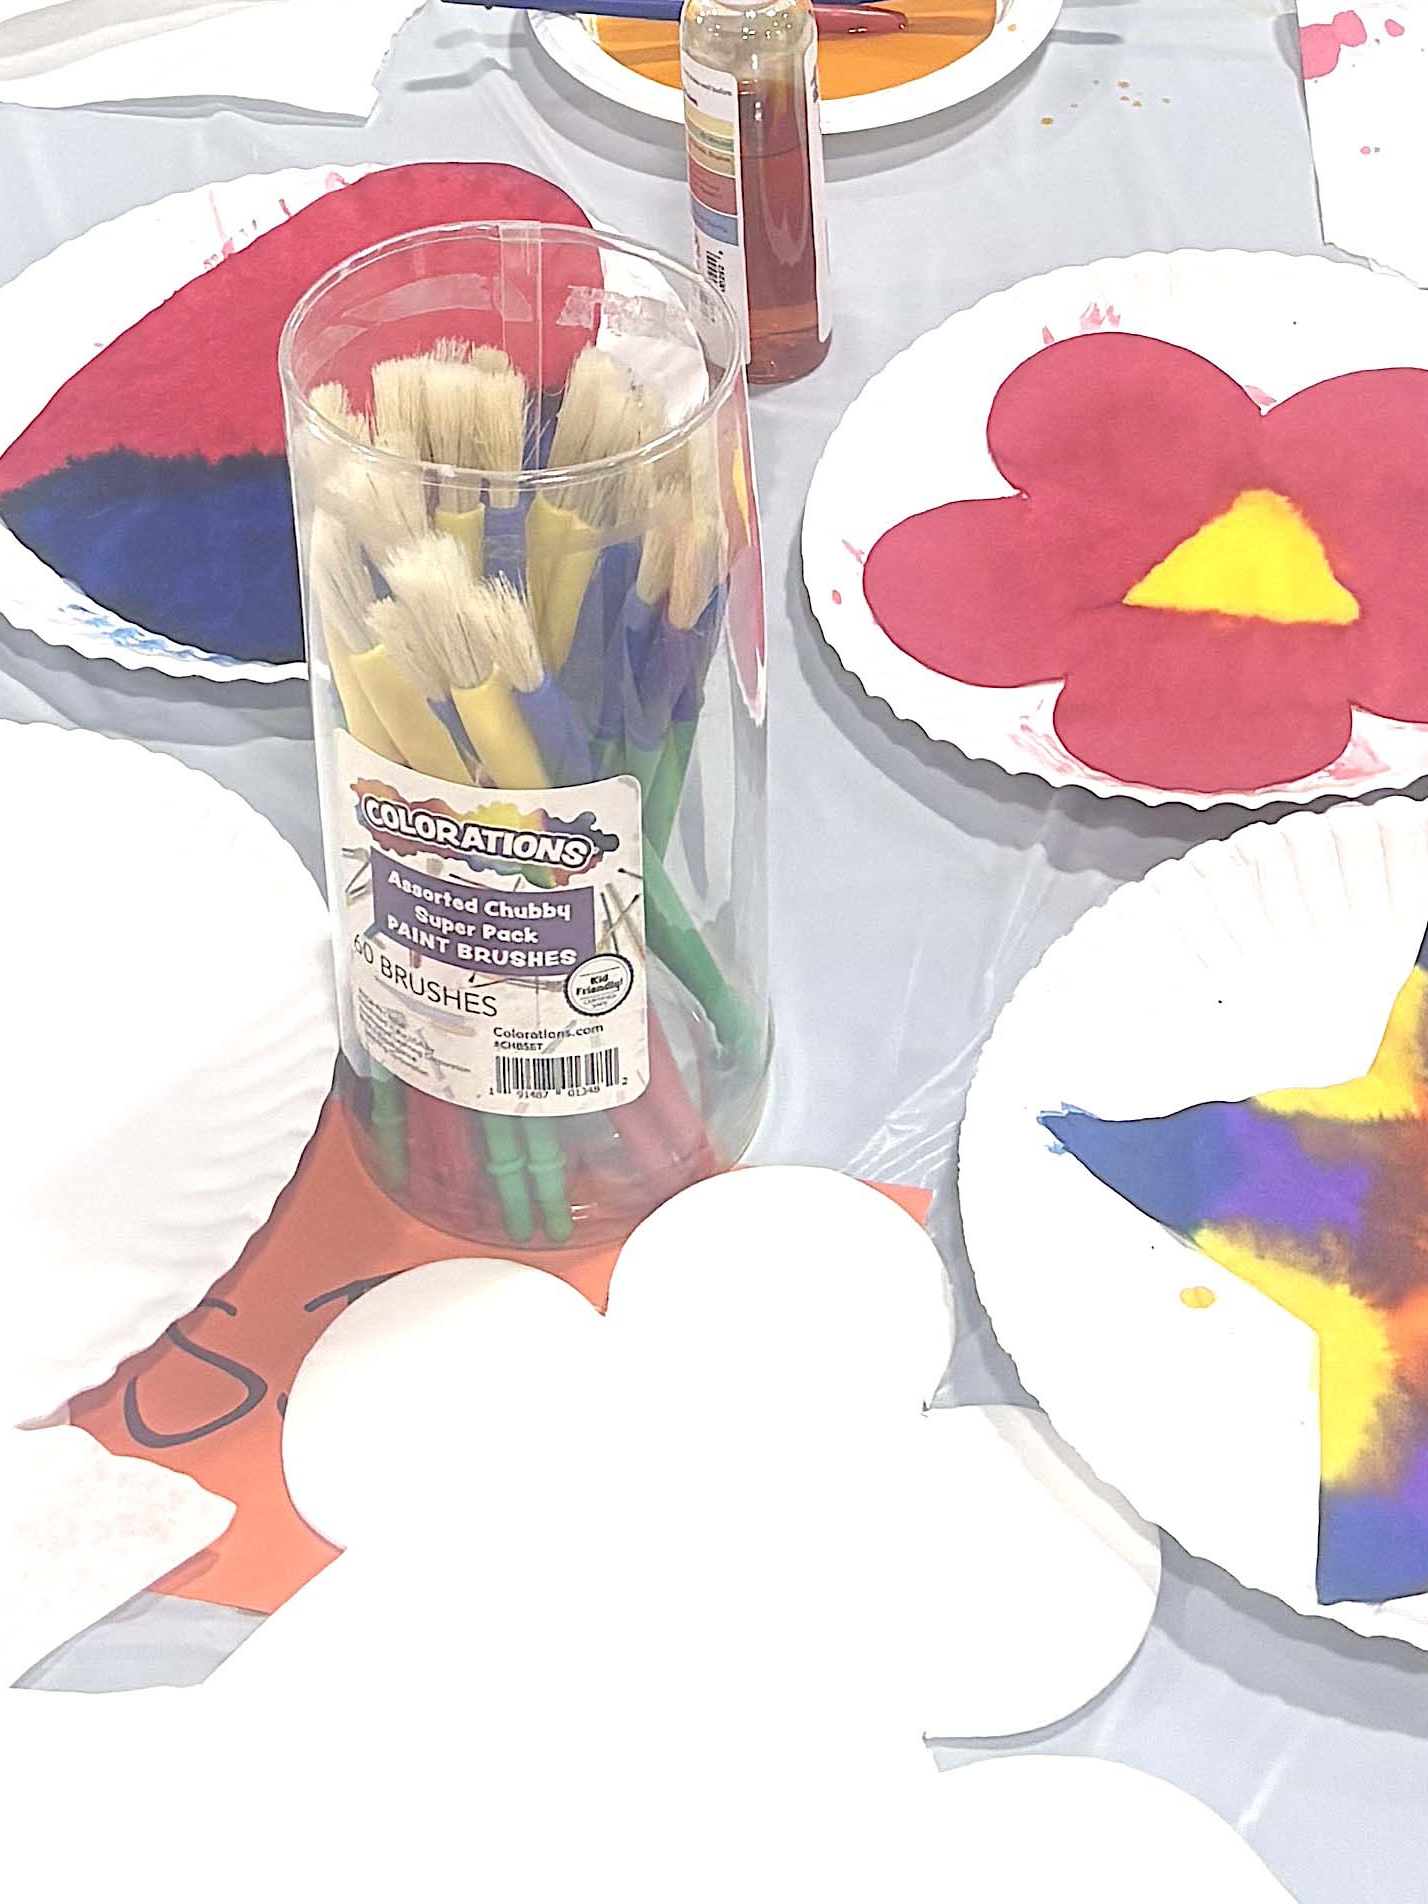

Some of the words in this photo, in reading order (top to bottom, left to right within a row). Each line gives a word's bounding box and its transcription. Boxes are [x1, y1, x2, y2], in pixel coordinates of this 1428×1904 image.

[364, 797, 587, 868] COLORATIONS
[387, 870, 478, 914] Assorted
[483, 899, 572, 922] Chubby
[387, 914, 450, 954] PAINT
[457, 941, 578, 968] BRUSHES
[414, 904, 476, 937] Super
[482, 923, 539, 944] Pack
[353, 932, 375, 966] 60
[379, 953, 498, 1018] BRUSHES
[590, 973, 609, 985] Kid
[493, 1023, 604, 1040] Colorations.com
